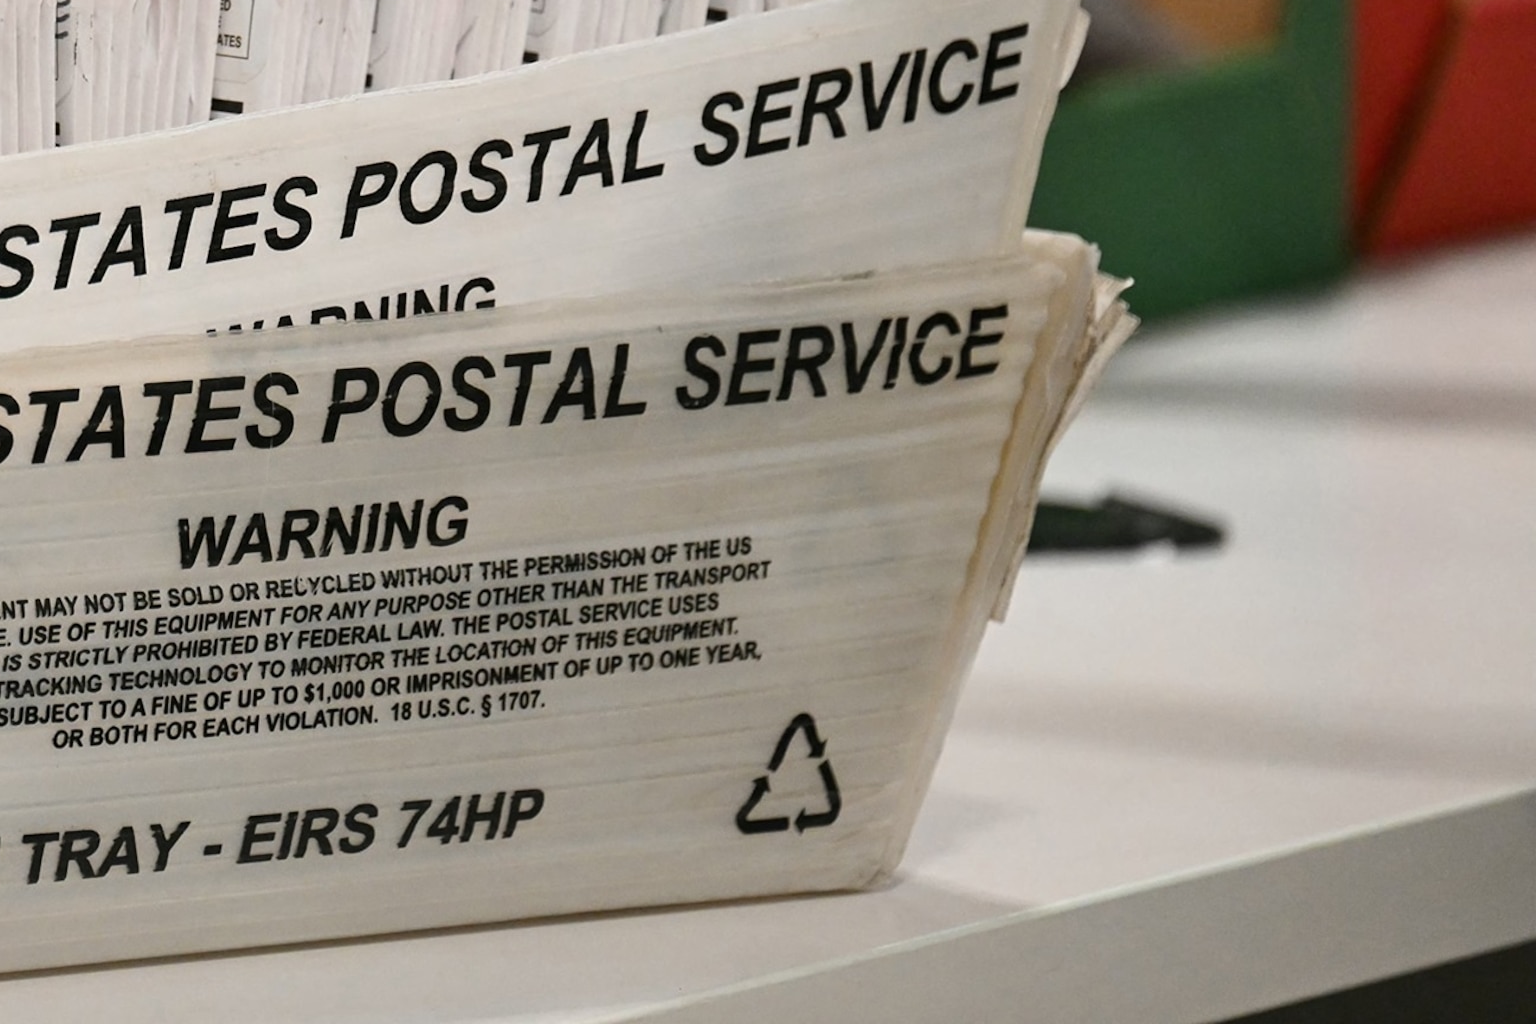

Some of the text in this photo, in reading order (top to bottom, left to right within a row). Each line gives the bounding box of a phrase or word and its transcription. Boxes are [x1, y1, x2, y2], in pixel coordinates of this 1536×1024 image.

[339, 109, 664, 239] POSTAL
[693, 23, 1028, 167] SERVICE
[320, 342, 646, 443] POSTAL
[675, 304, 1008, 410] SERVICE
[177, 494, 469, 570] WARNING
[18, 624, 62, 646] USE
[66, 621, 96, 642] OF
[102, 617, 148, 639] THIS
[153, 607, 276, 635] EQUIPMENT
[280, 603, 323, 625] FOR
[326, 599, 371, 621] ANY
[373, 590, 471, 617] PURPOSE
[476, 583, 545, 607] OTHER
[551, 578, 604, 600] THAN
[610, 573, 648, 594] THE
[654, 560, 771, 589] TRANSPORT
[34, 594, 78, 618] MAY
[83, 591, 127, 615] NOT
[132, 589, 162, 611] BE
[167, 584, 224, 608] SOLD
[229, 581, 260, 602] OR
[265, 571, 376, 599] RECYCLED
[380, 562, 473, 589] WITHOUT
[478, 558, 518, 580] THE
[523, 547, 646, 576] PERMISSION
[650, 543, 677, 564] OF
[683, 539, 720, 561] THE
[726, 536, 751, 556] US
[1, 653, 22, 672] IS
[27, 644, 129, 670] STRICTLY
[132, 634, 258, 663] PROHIBITED
[263, 630, 294, 652] BY
[296, 623, 394, 649] FEDERAL
[397, 618, 444, 641] LAW.
[451, 614, 490, 635] THE
[495, 607, 573, 632] POSTAL
[578, 597, 663, 624] SERVICE
[668, 592, 719, 615] USES
[108, 661, 253, 691] TECHNOLOGY
[257, 659, 286, 680] TO
[290, 650, 385, 677] MONITOR
[390, 646, 430, 668] THE
[434, 636, 536, 664] LOCATION
[540, 633, 569, 654] OF
[574, 629, 618, 650] THIS
[623, 616, 738, 646] EQUIPMENT.
[51, 689, 545, 749] OR BOTH FOR EACH VIOLATION. 18 U.S.C. § 1707.
[98, 698, 126, 720] TO
[130, 697, 146, 717] A
[150, 693, 198, 716] FINE
[202, 690, 232, 711] OF
[237, 687, 266, 708] UP
[270, 684, 298, 705] TO
[303, 678, 365, 706] $1,000
[370, 676, 400, 697] OR
[406, 661, 559, 693] IMPRISONMENT
[563, 658, 591, 678] OF
[596, 655, 623, 675] UP
[628, 651, 654, 672] TO
[659, 647, 700, 668] ONE
[706, 641, 761, 664] YEAR,
[20, 820, 191, 884] TRAY
[235, 802, 378, 864] EIRS
[396, 788, 544, 849] 74HP
